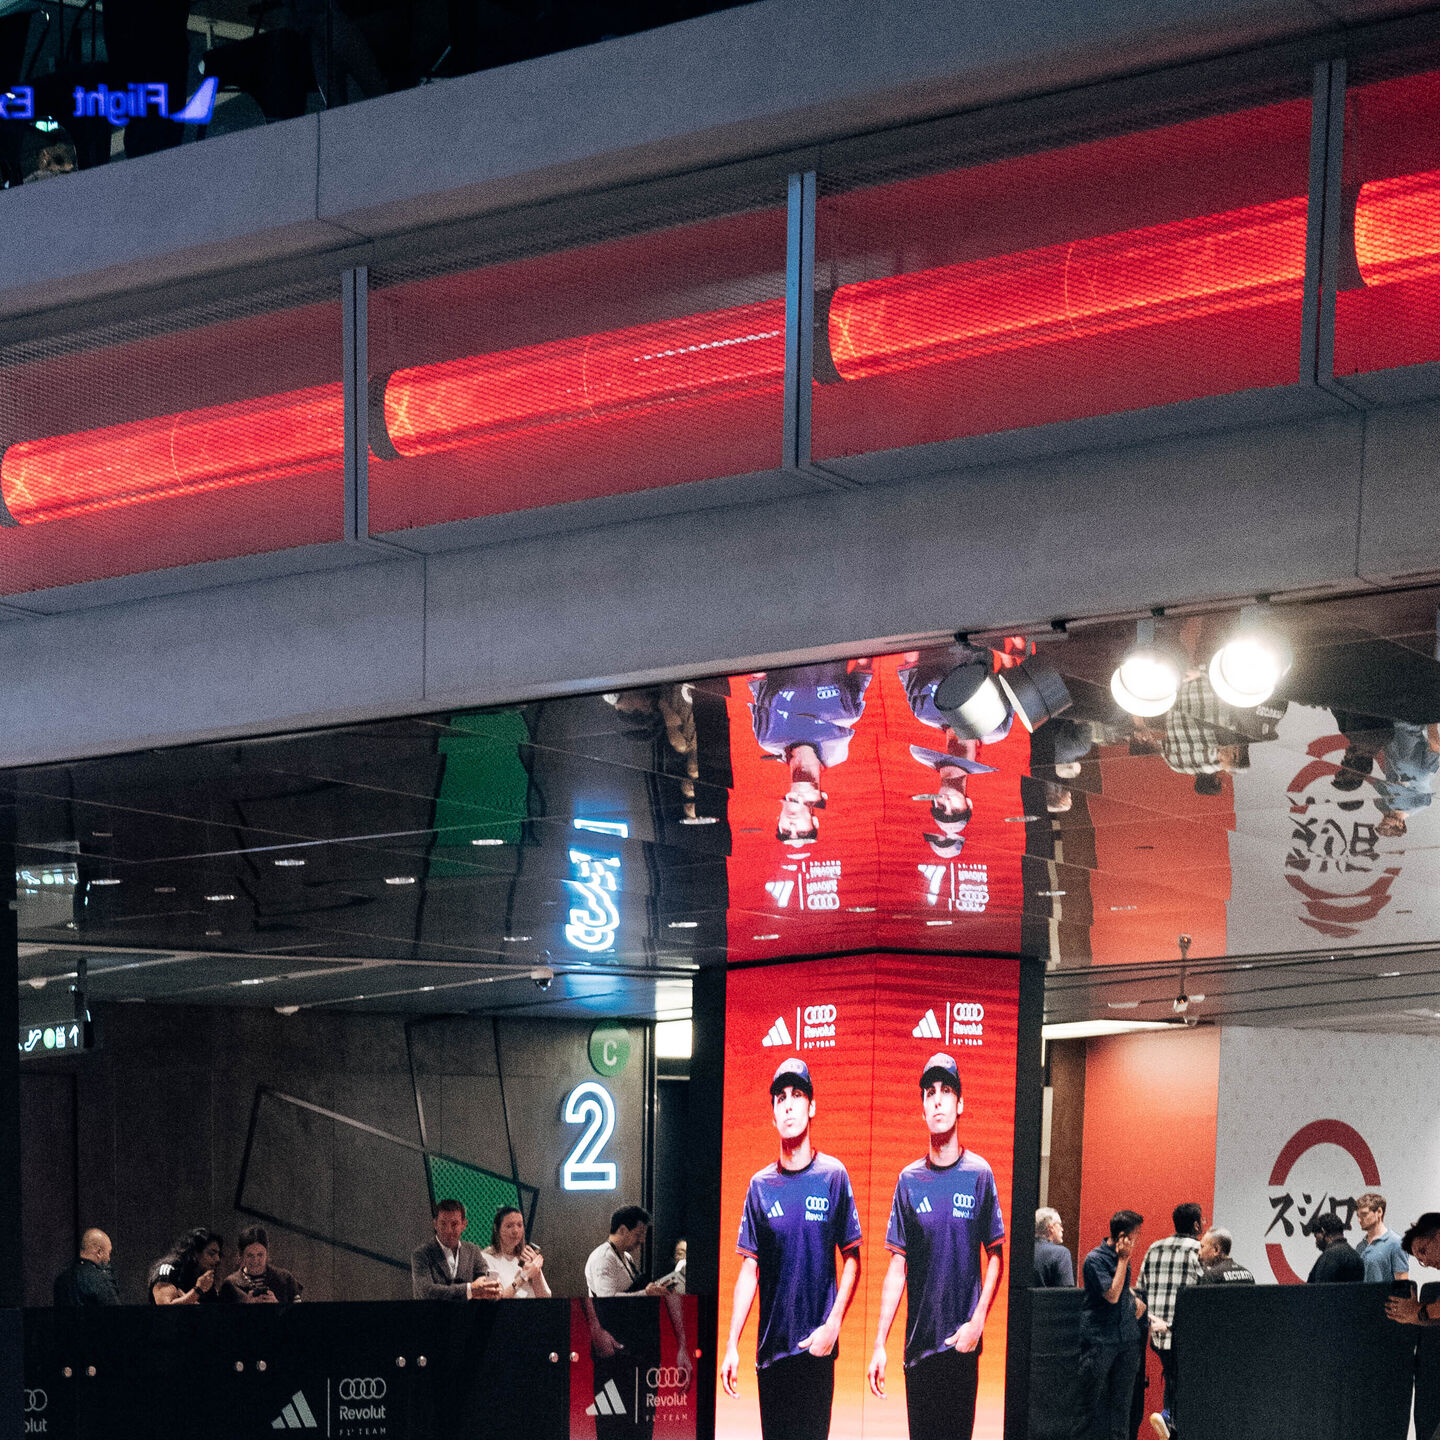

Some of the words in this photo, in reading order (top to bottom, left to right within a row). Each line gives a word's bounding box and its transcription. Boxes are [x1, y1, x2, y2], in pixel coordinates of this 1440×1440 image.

[603, 1039, 617, 1066] C
[564, 1081, 618, 1191] 2
[1265, 1192, 1359, 1237] スシロ
[339, 1405, 387, 1420] Revolut
[646, 1393, 688, 1407] Revolut
